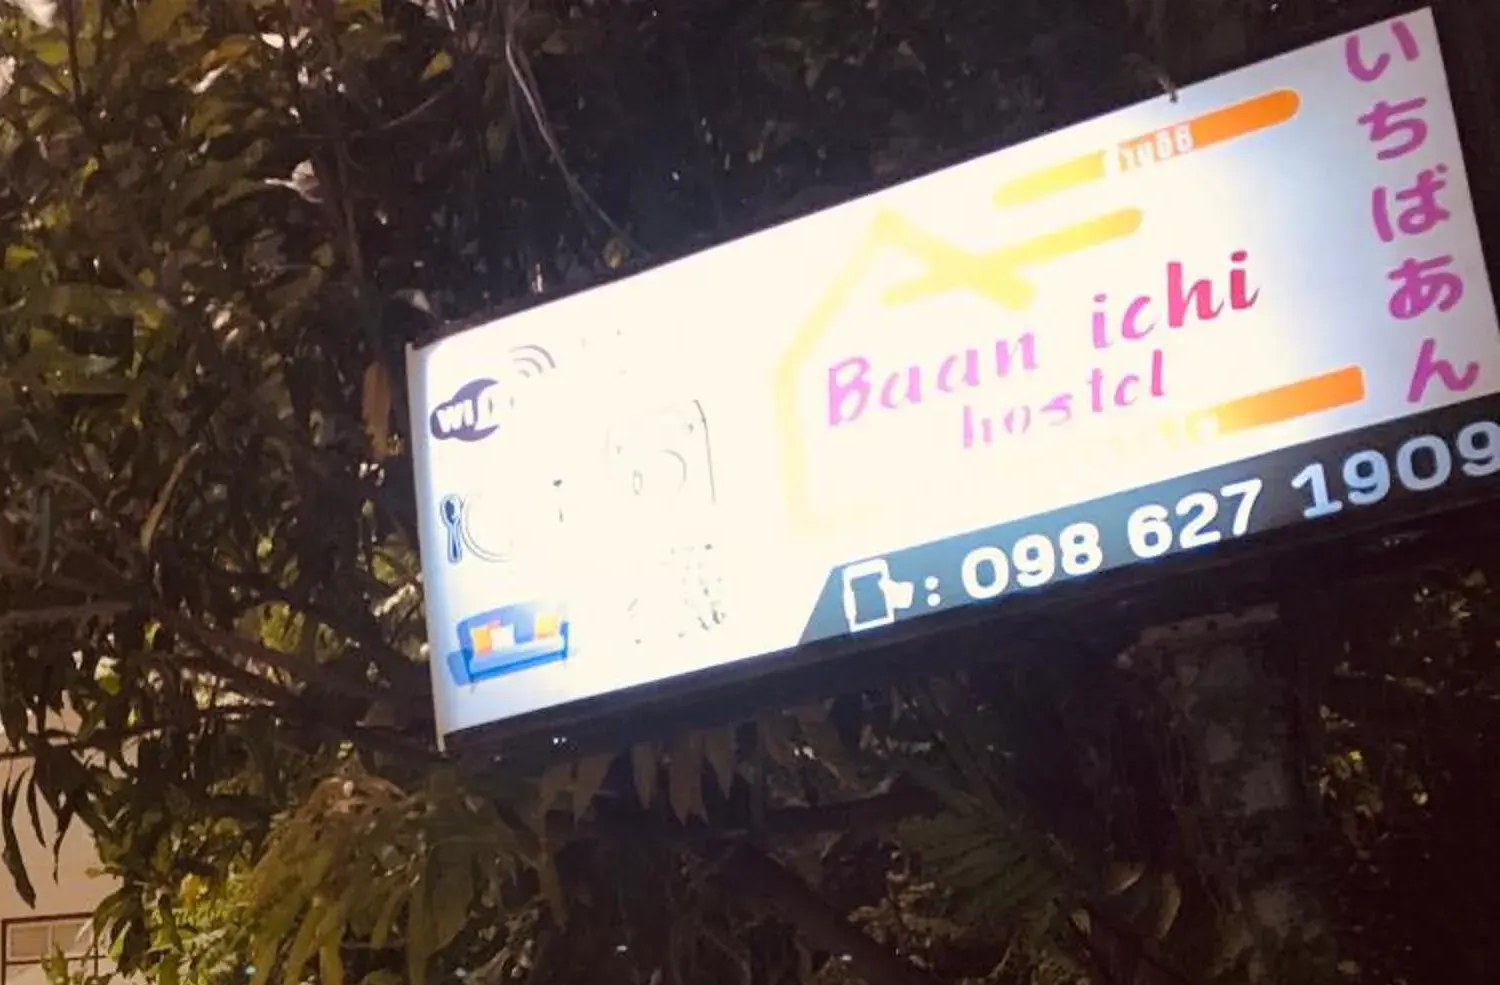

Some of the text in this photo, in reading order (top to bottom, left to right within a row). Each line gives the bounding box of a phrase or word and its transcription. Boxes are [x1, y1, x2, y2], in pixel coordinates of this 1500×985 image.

[1344, 20, 1480, 404] いちばあん
[828, 250, 1260, 427] Baan ichi
[961, 521, 1104, 601] 098
[1127, 478, 1264, 558] 627
[1290, 420, 1500, 519] 1909
